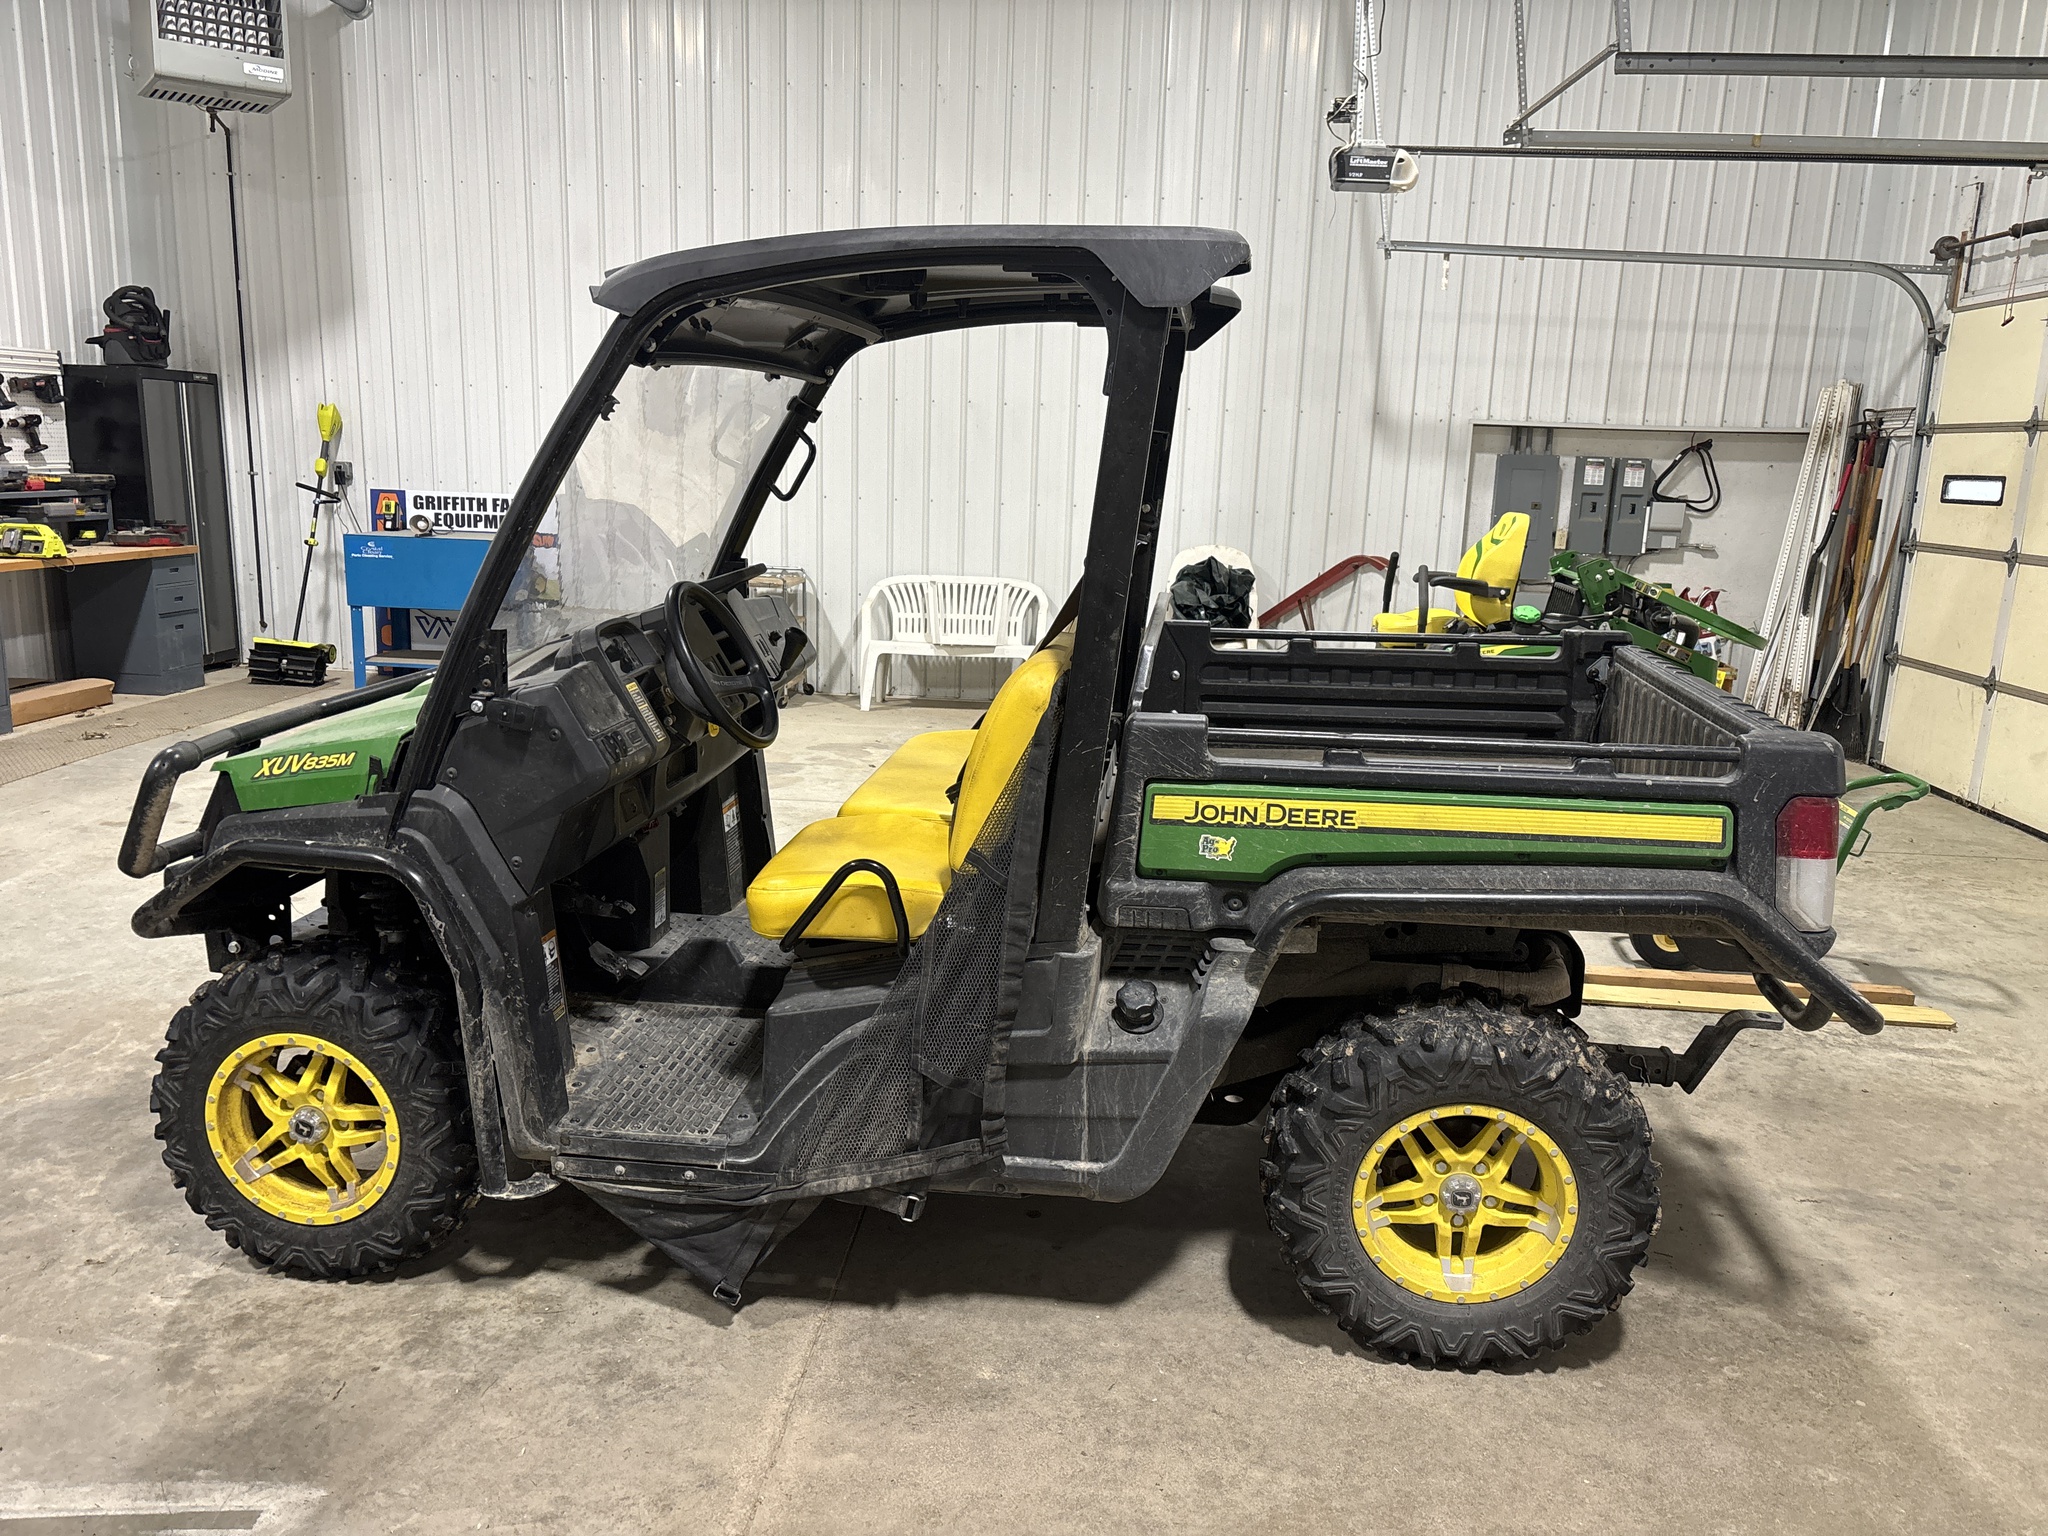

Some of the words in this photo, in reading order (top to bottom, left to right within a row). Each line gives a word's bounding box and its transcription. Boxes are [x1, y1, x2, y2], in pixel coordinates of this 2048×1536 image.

[413, 494, 487, 511] GRIFFITH
[492, 498, 513, 513] FA
[1184, 801, 1259, 823] JOHN
[1266, 803, 1357, 826] DEERE
[1202, 845, 1219, 853] Pro
